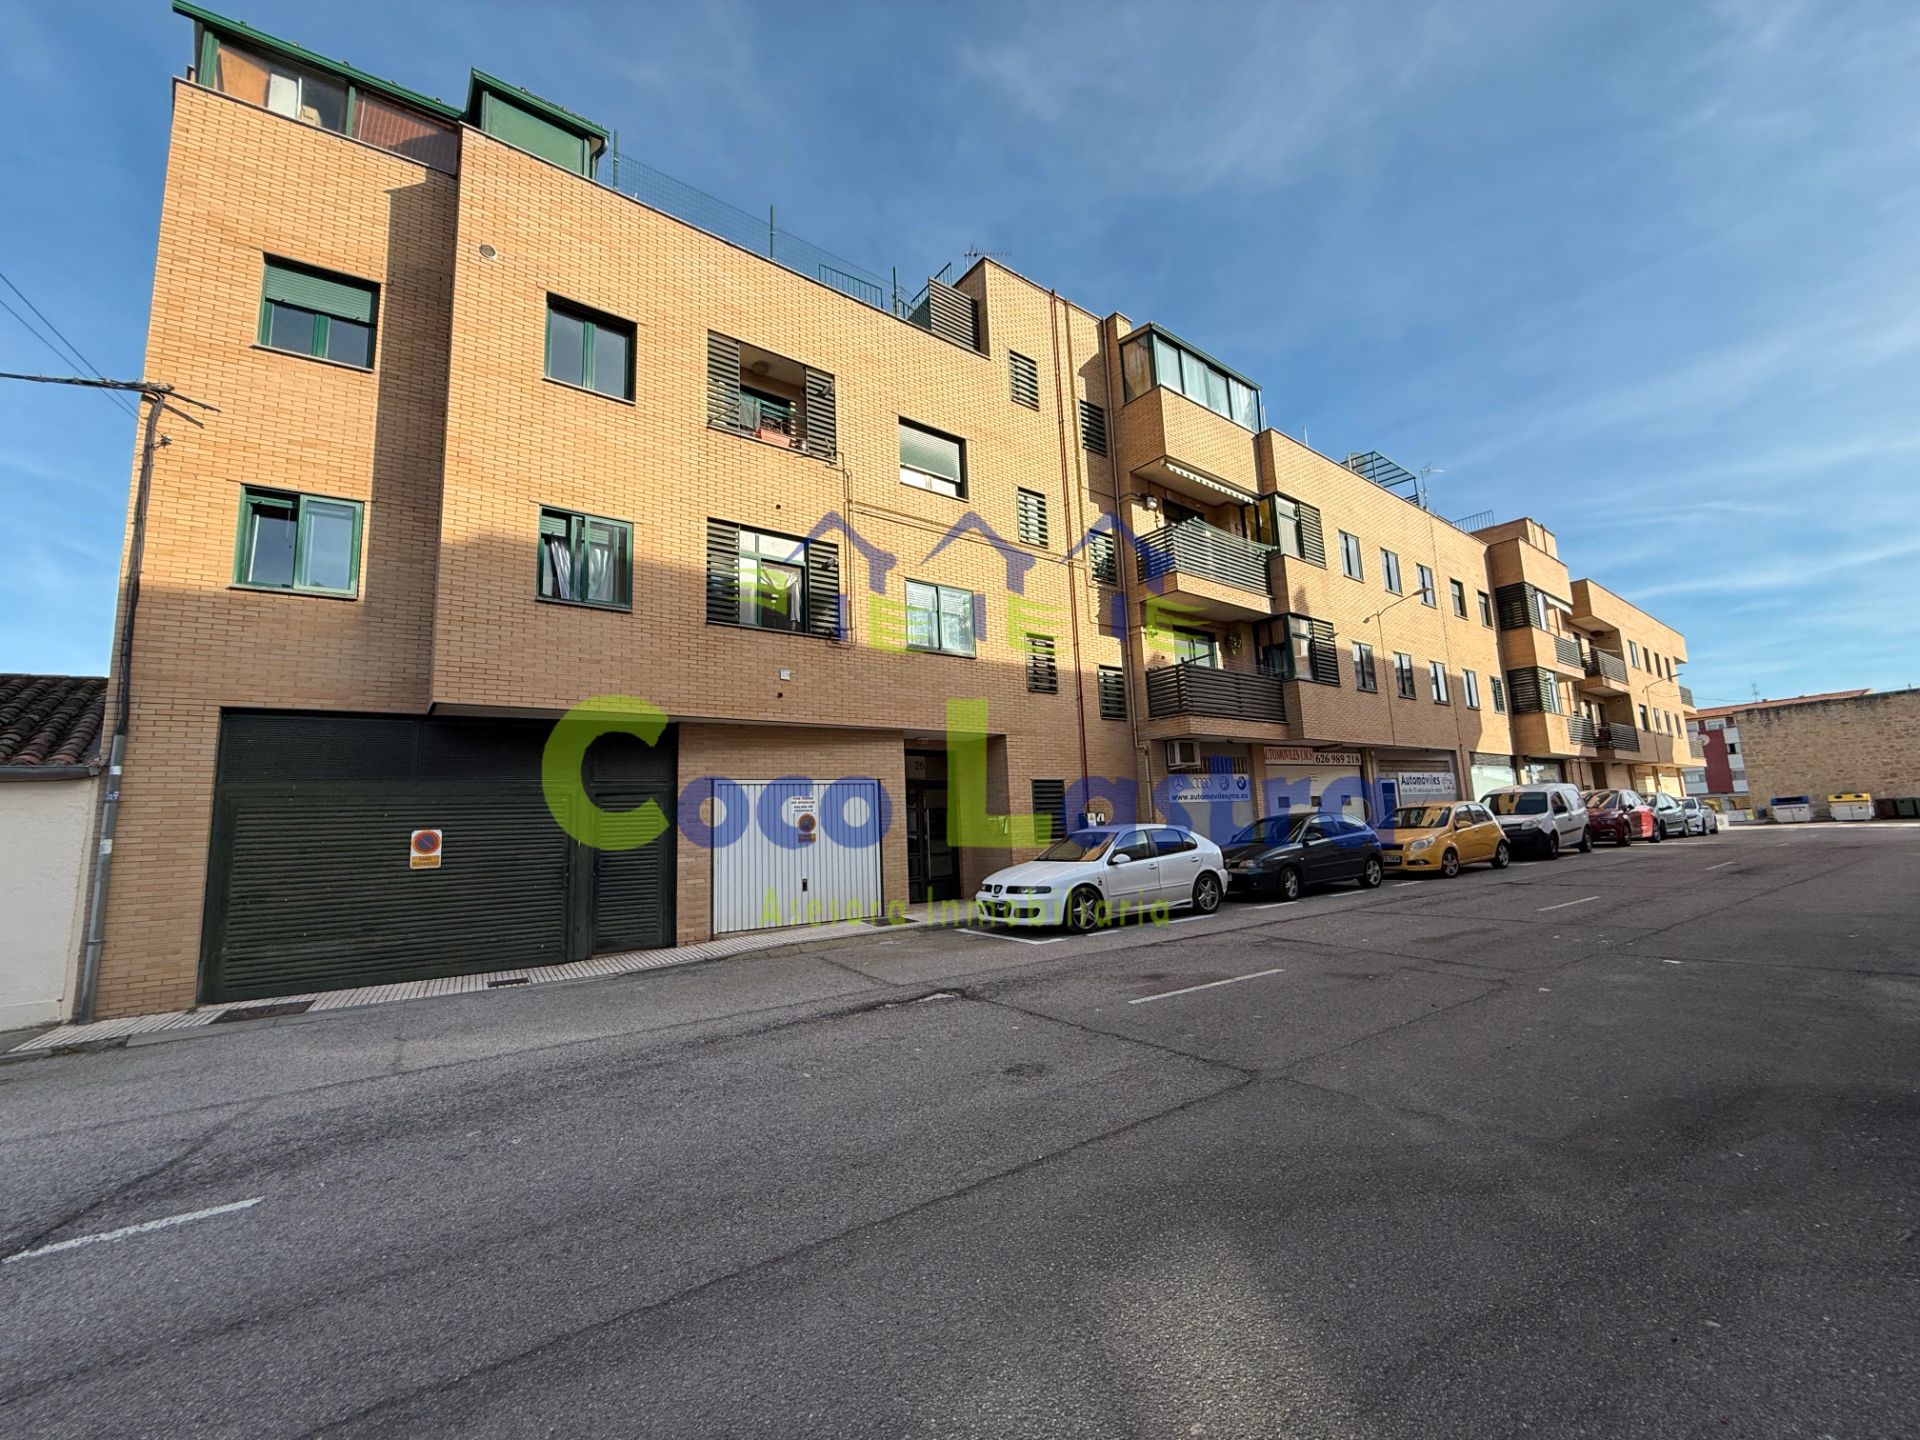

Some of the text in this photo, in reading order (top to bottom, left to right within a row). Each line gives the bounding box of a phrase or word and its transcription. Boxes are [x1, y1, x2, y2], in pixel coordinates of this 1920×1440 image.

[1315, 753, 1360, 764] 626 989 218
